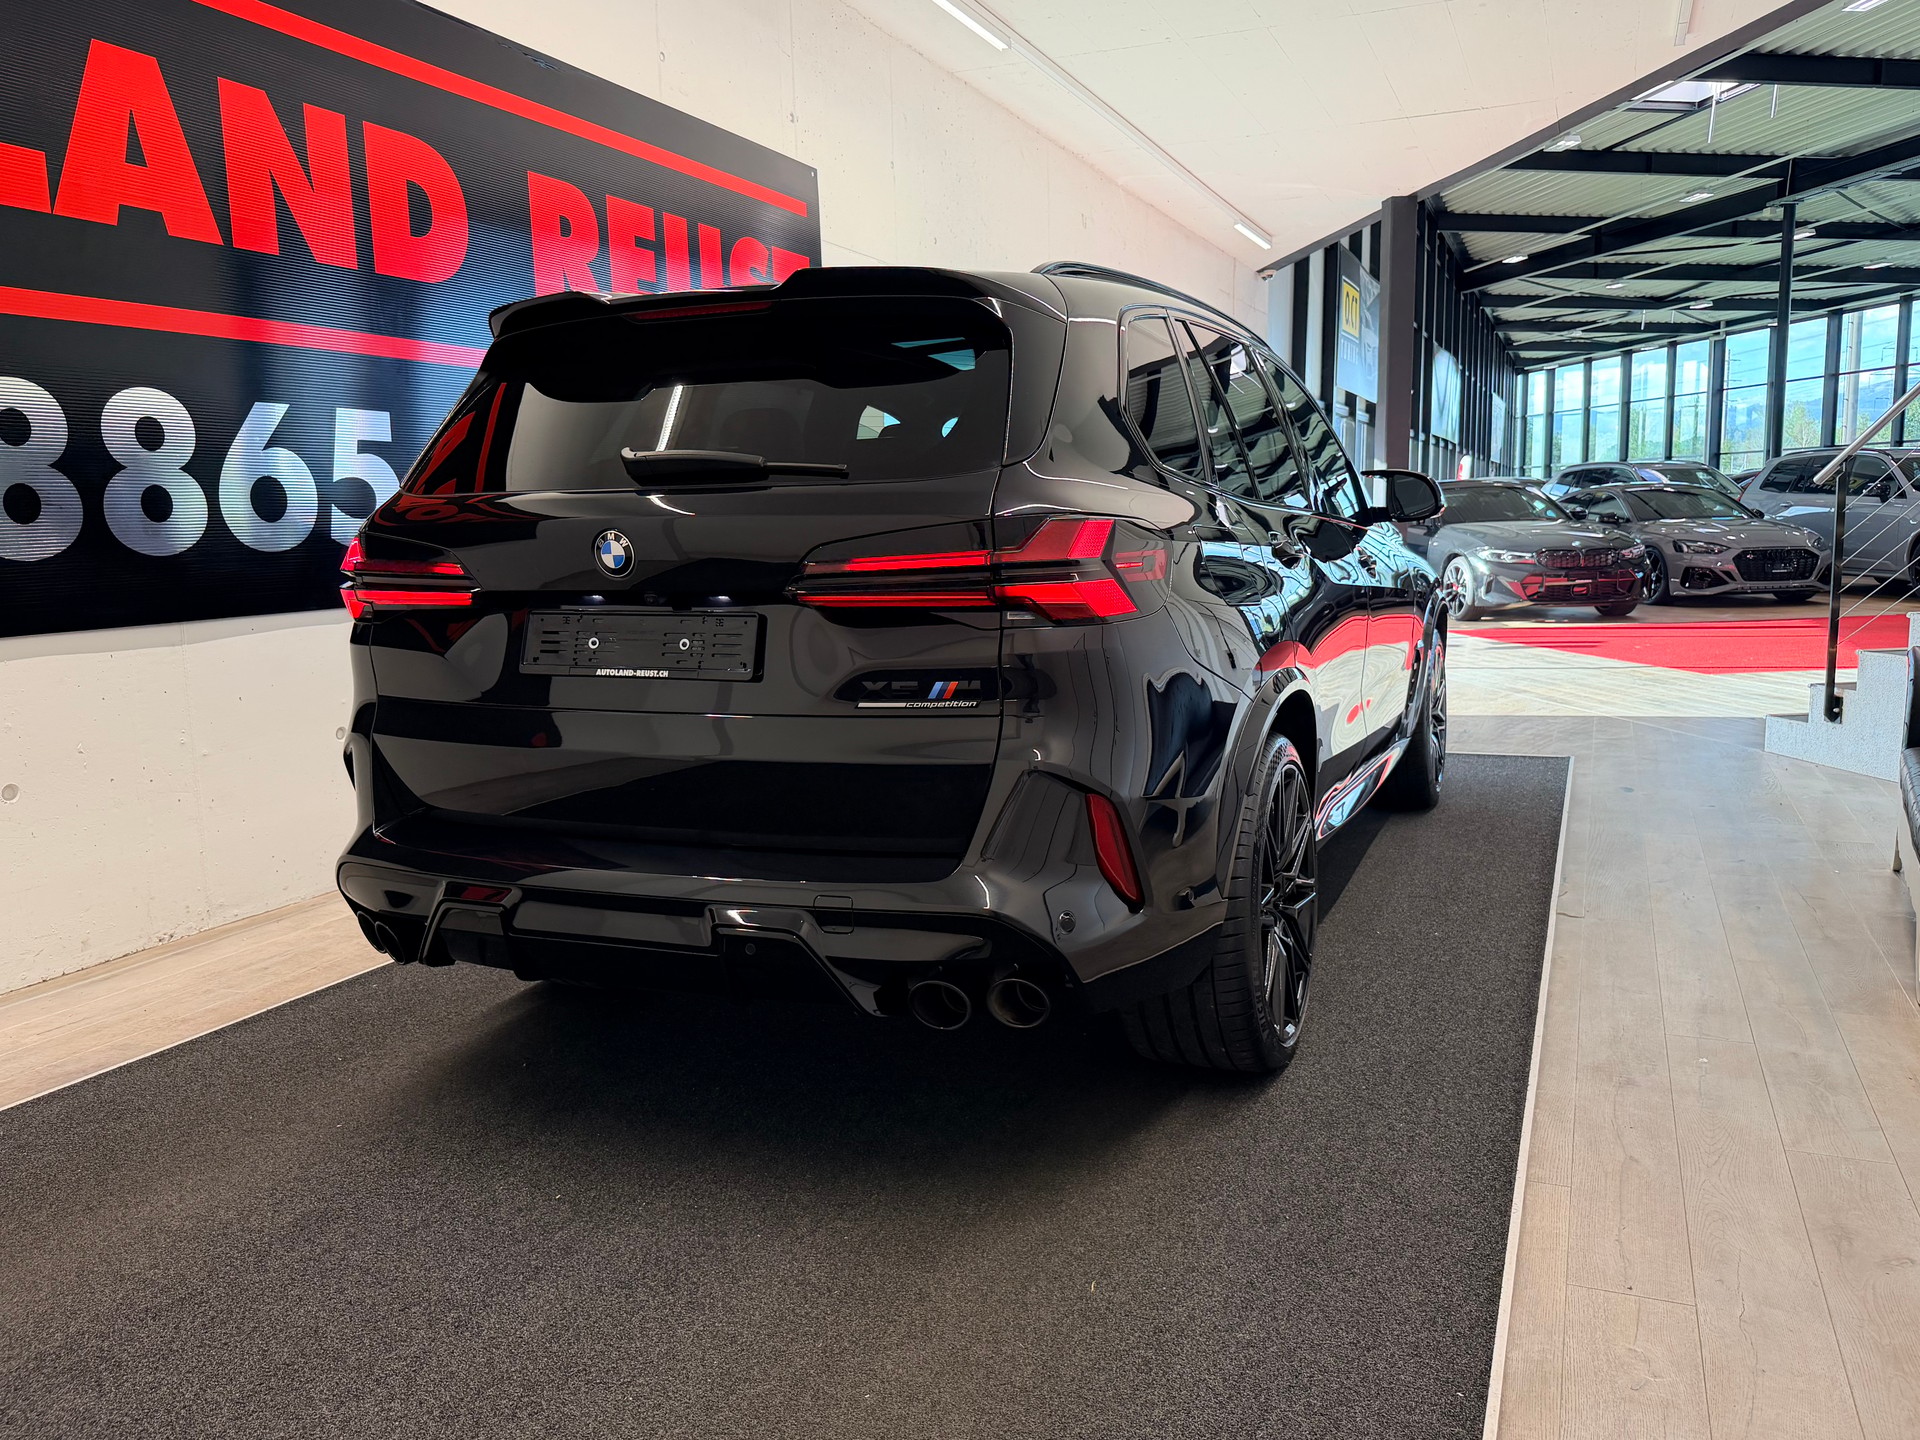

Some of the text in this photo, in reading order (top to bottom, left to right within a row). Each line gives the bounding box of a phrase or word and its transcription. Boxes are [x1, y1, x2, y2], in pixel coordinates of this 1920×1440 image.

[0, 376, 400, 561] 8865
[595, 668, 669, 678] AUTOLAND-REUST.CH
[906, 700, 978, 709] competition
